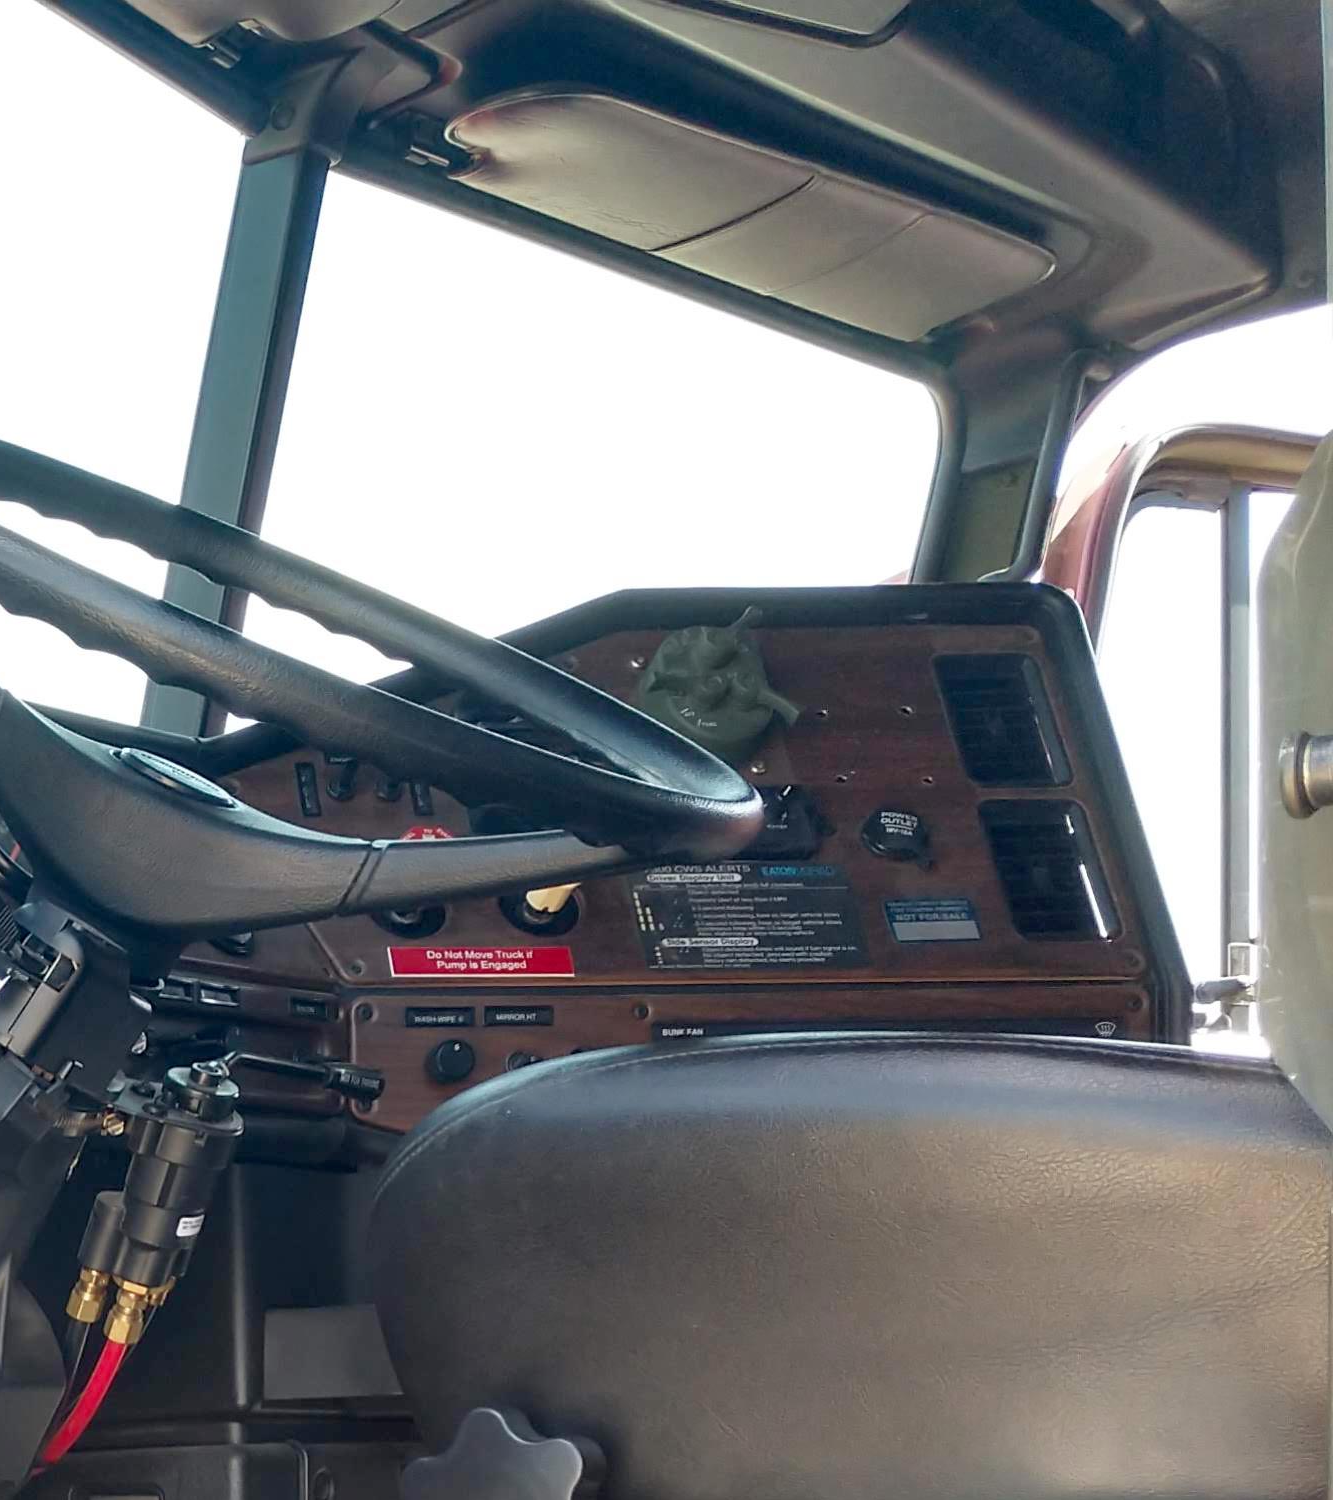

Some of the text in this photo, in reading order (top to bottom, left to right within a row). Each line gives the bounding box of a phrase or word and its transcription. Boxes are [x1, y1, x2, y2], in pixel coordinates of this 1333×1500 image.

[880, 817, 918, 828] OUTLET
[705, 865, 751, 874] ALERTS
[426, 949, 534, 960] Do Not Move Truck if
[437, 960, 527, 971] Pump is Engaged
[662, 1027, 704, 1037] BUNK FAN
